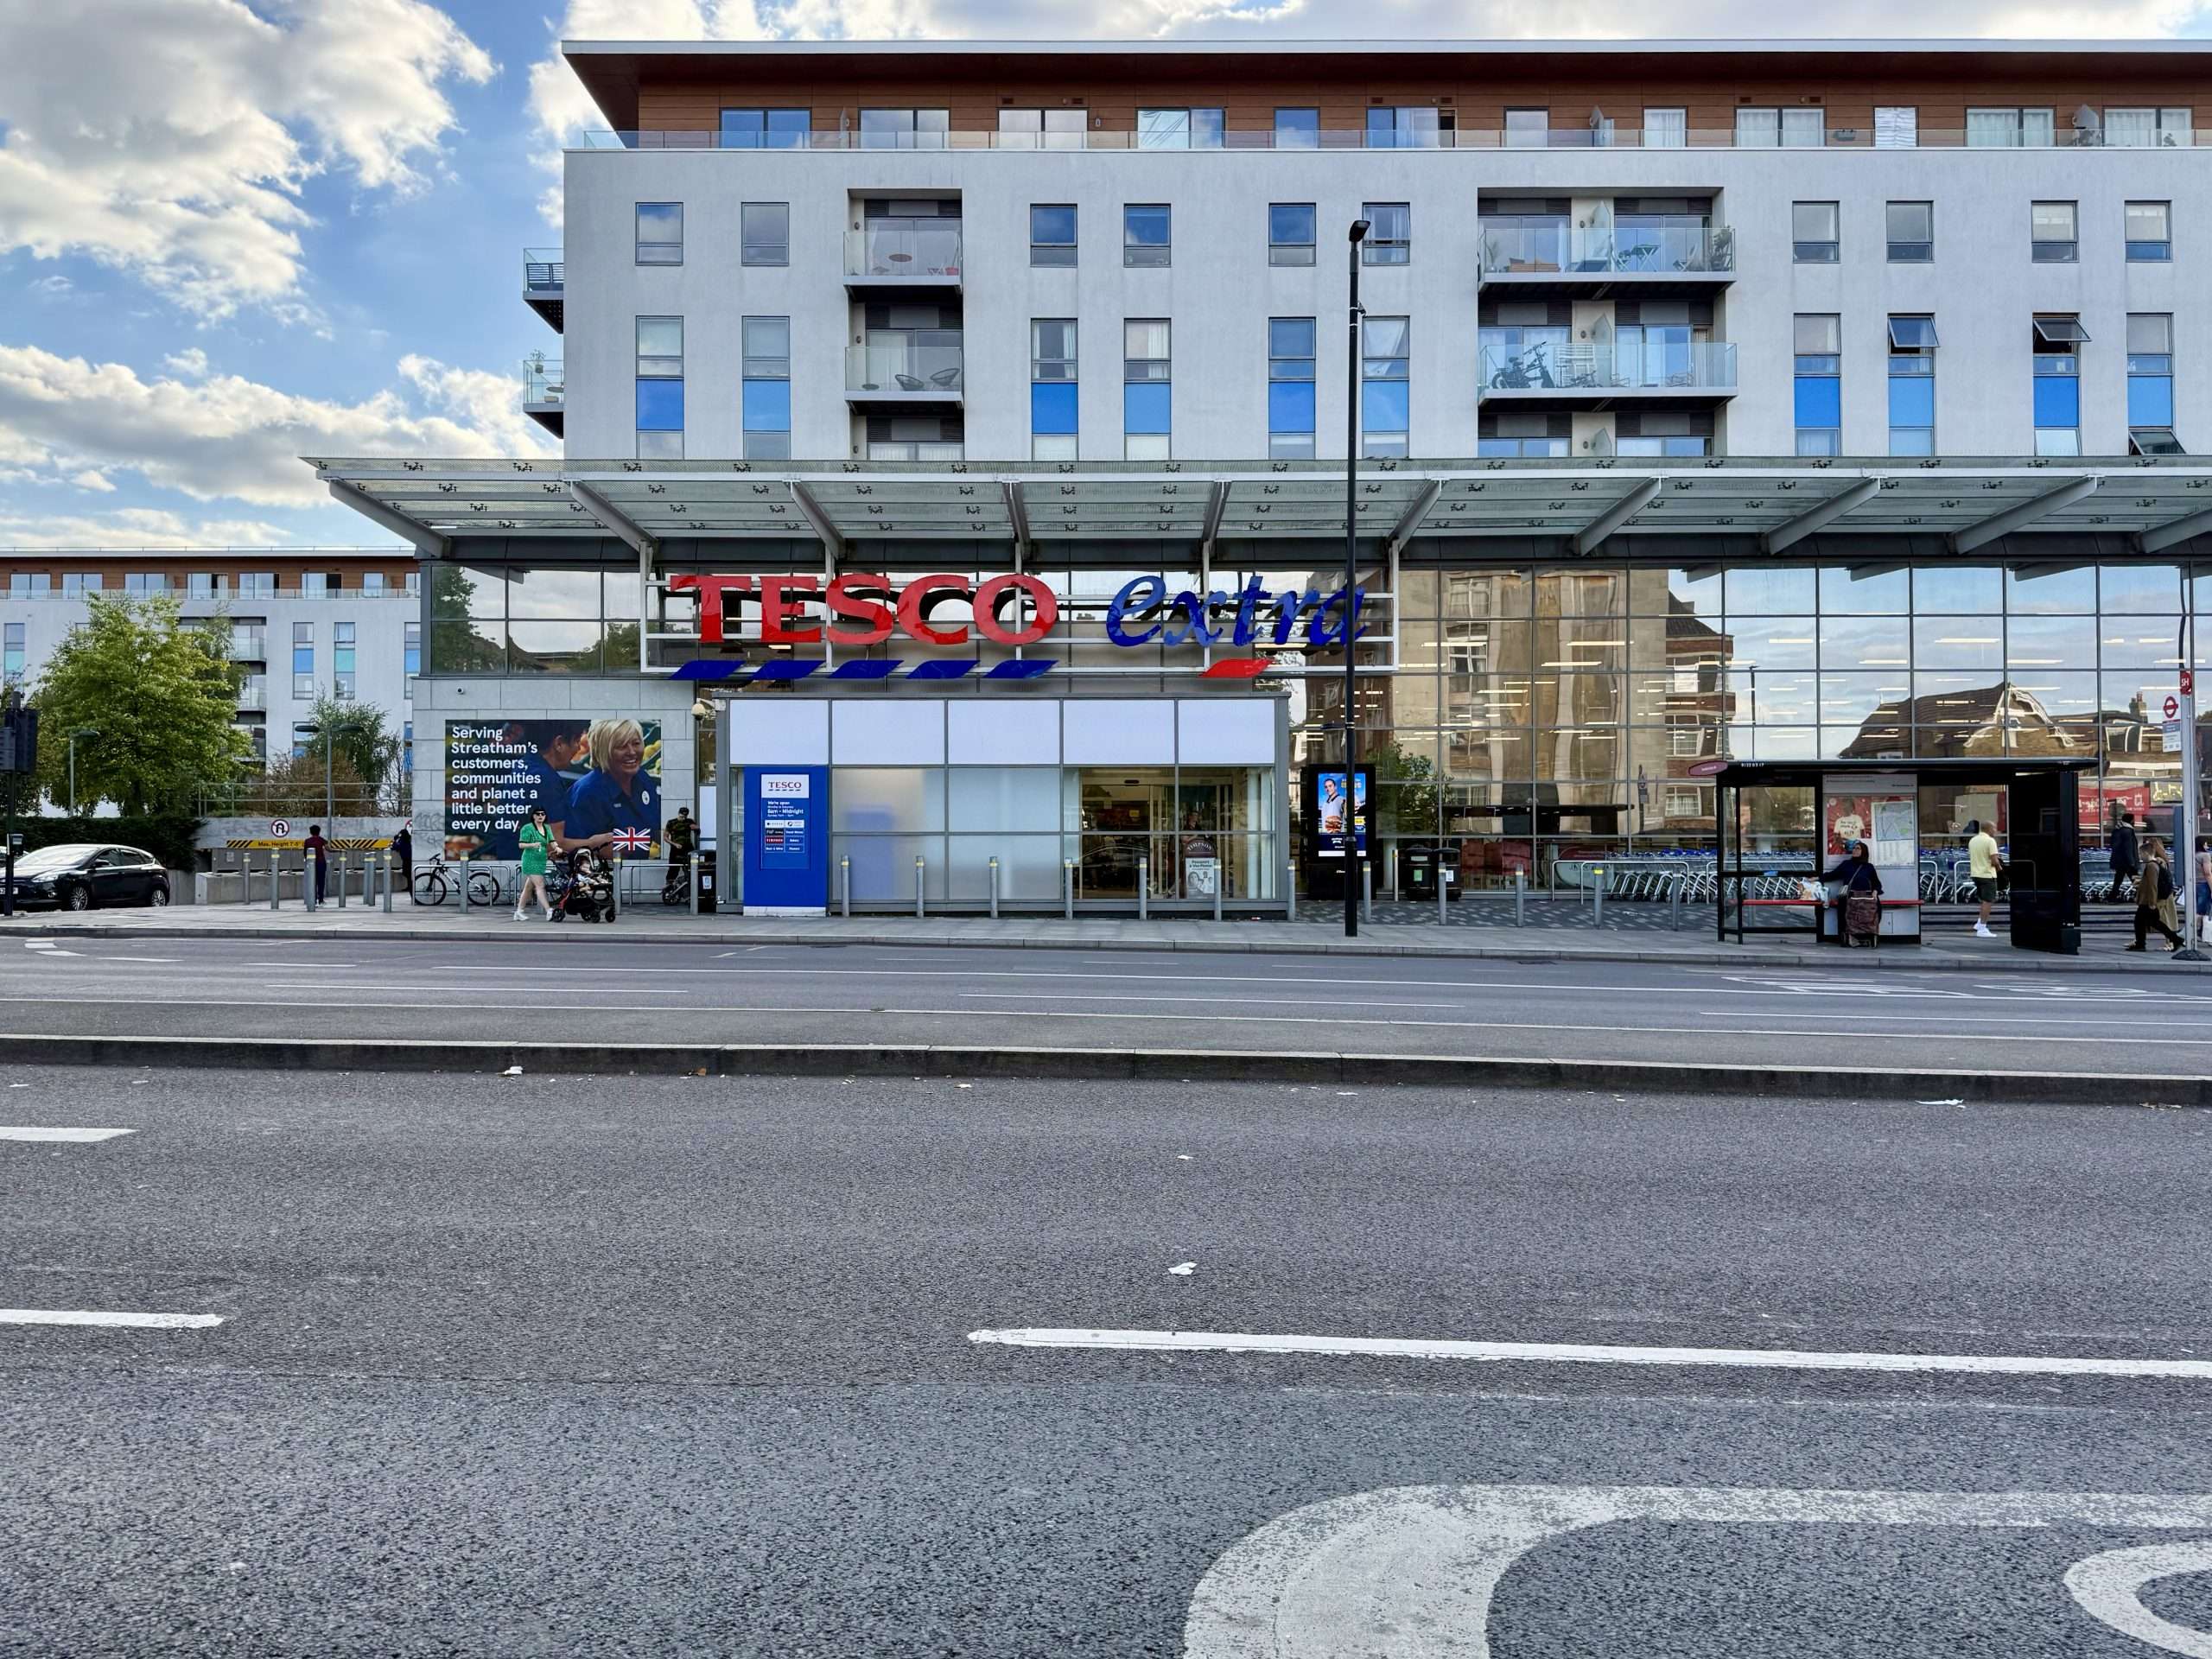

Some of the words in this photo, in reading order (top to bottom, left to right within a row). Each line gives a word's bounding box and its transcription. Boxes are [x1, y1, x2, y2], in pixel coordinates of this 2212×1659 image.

[671, 574, 1056, 645] TESCO
[1106, 575, 1369, 647] extra
[452, 727, 503, 741] Serving
[452, 758, 528, 770] customers,
[452, 772, 541, 785] communities
[452, 787, 478, 799] and
[482, 787, 525, 802] planet
[530, 791, 537, 799] a
[452, 802, 483, 815] little
[487, 803, 531, 815] better
[452, 820, 490, 832] every
